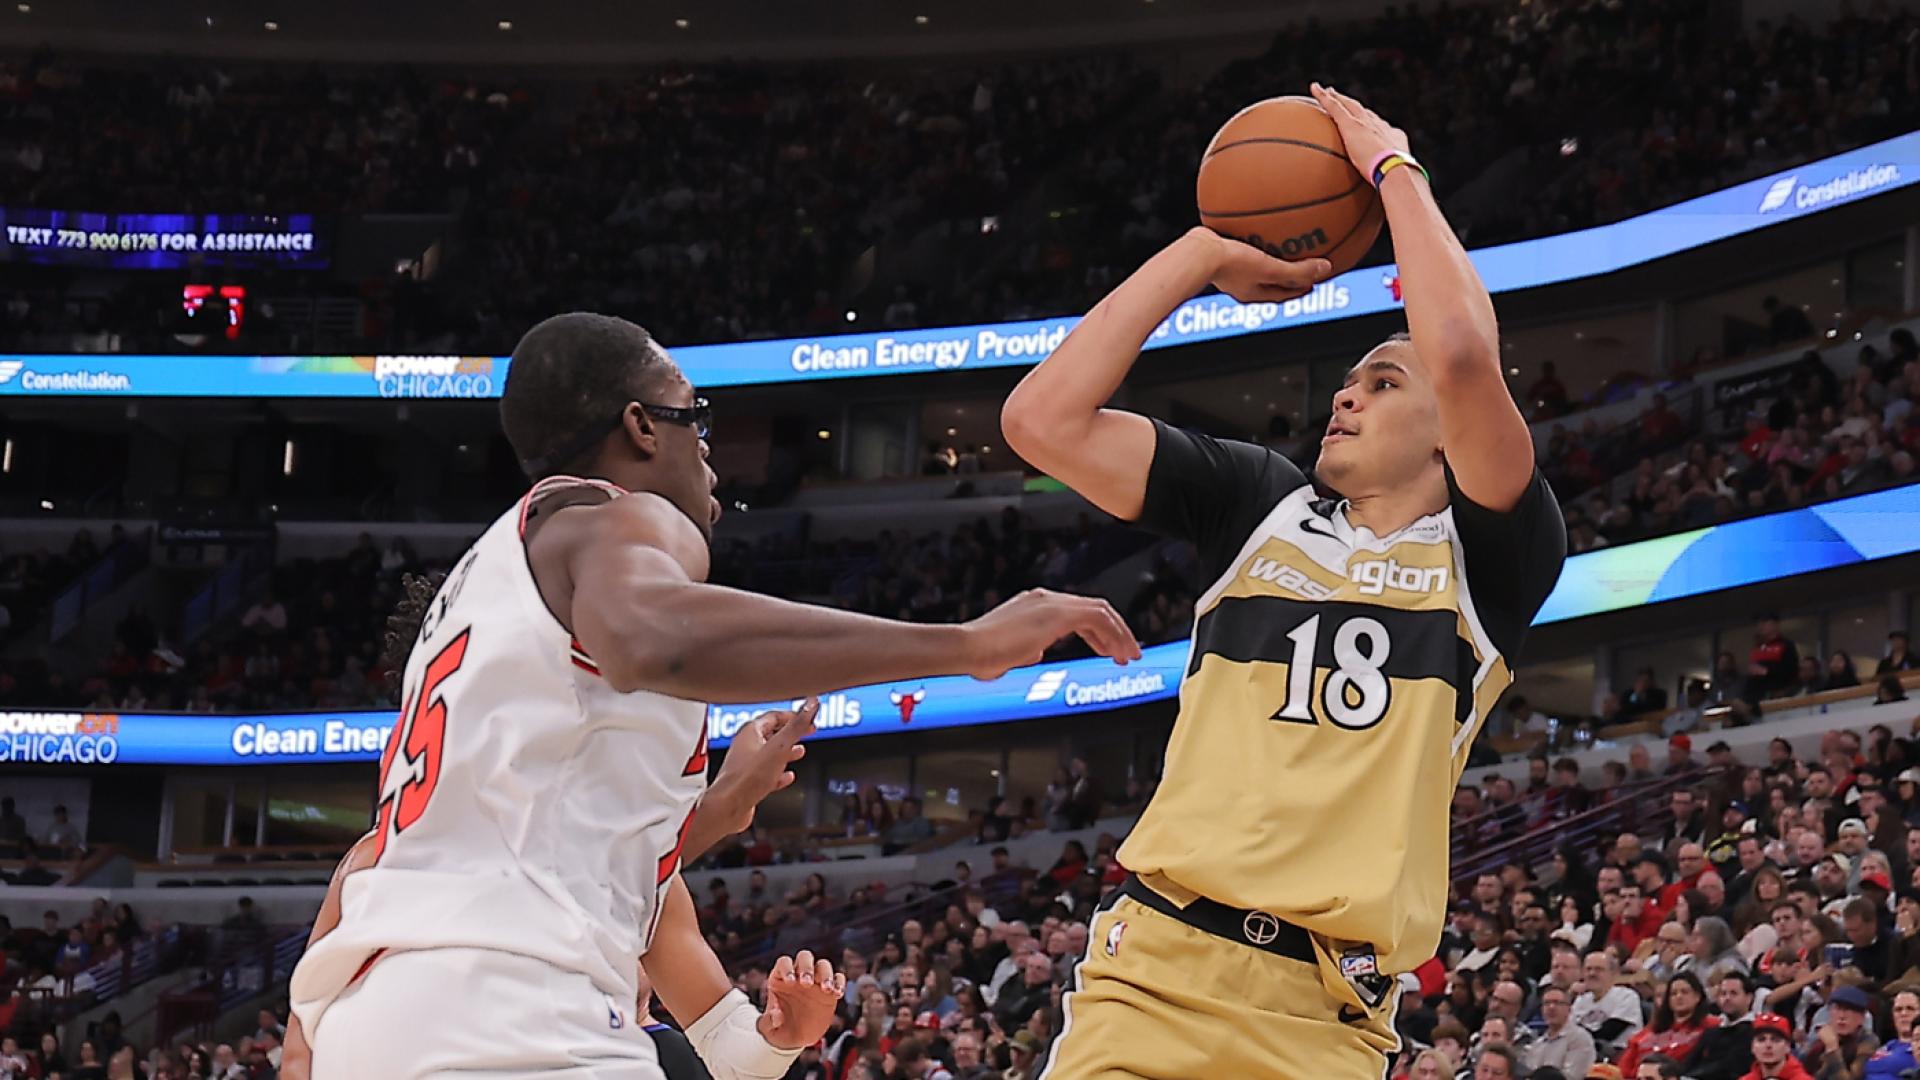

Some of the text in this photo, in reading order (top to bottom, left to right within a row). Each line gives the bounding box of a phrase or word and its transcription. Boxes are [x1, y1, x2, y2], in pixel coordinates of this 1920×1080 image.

[7, 226, 313, 251] TEXT 773 900 6176 FOR ASSISTANCE
[791, 343, 868, 372] Clean
[875, 338, 969, 368] Energy
[977, 325, 1067, 359] Provid
[1174, 301, 1277, 330] Chicago
[379, 375, 492, 398] CHICAGO
[1268, 612, 1392, 730] 18
[232, 722, 318, 756] Clean
[324, 720, 392, 753] Ener
[791, 692, 862, 729] ulls
